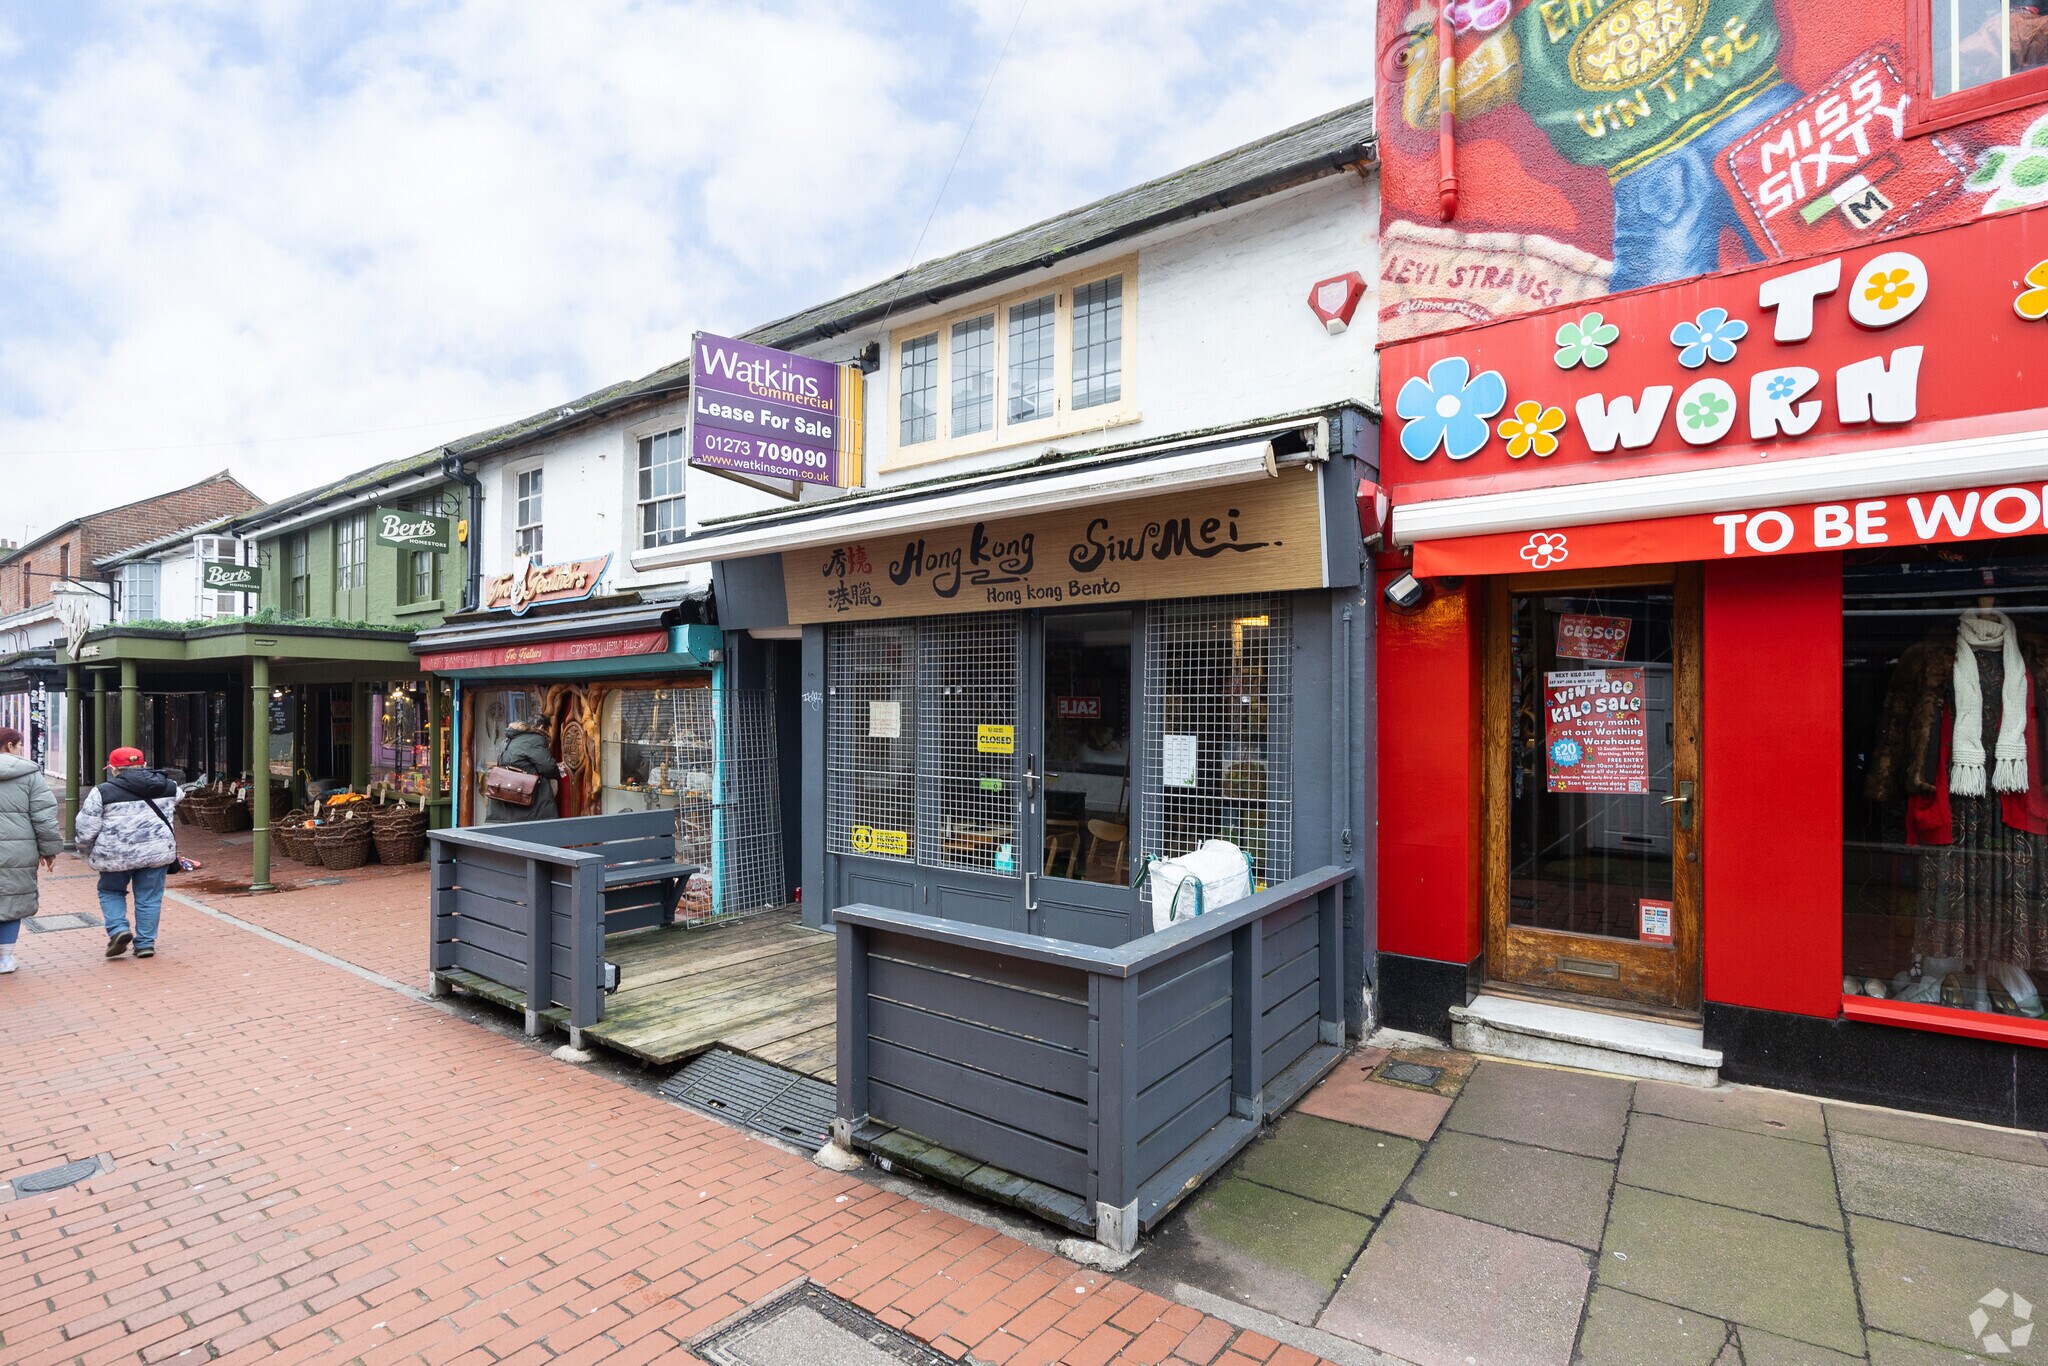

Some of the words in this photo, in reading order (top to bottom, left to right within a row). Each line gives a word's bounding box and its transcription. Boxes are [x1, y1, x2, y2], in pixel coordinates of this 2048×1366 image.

[1585, 6, 1683, 69] WORN
[1601, 22, 1687, 82] AGAIN
[1574, 15, 1760, 138] VINTAGE
[1761, 69, 1882, 175] MISS
[1758, 93, 1911, 220] SIXTY
[1848, 190, 1889, 224] M
[1447, 263, 1563, 308] STRAUSS
[1759, 251, 1928, 342] TO
[701, 344, 819, 398] Watkins
[748, 380, 833, 412] Commercial
[1575, 345, 1924, 453] WORN
[697, 396, 755, 423] Lease
[760, 409, 790, 431] For
[794, 416, 832, 439] Sale
[701, 453, 829, 482] www.watkinscom.co.uk
[705, 434, 751, 456] 01273
[756, 440, 827, 469] 709090
[379, 514, 437, 543] Bert's
[1712, 511, 1795, 556] TO
[1813, 500, 1888, 548] BE
[1906, 484, 2048, 540] WO
[409, 538, 447, 548] HOMESTORE
[207, 565, 252, 587] Bert's
[889, 538, 962, 598] Hong
[229, 582, 260, 590] HOMESTORE
[986, 586, 1022, 605] Hong
[1068, 577, 1121, 597] Bento
[1576, 719, 1605, 728] Every
[1608, 717, 1640, 727] month
[1595, 727, 1643, 737] Worthing
[980, 735, 1012, 745] CLOSED
[1555, 743, 1577, 757] £20
[1583, 737, 1641, 746] Warehouse
